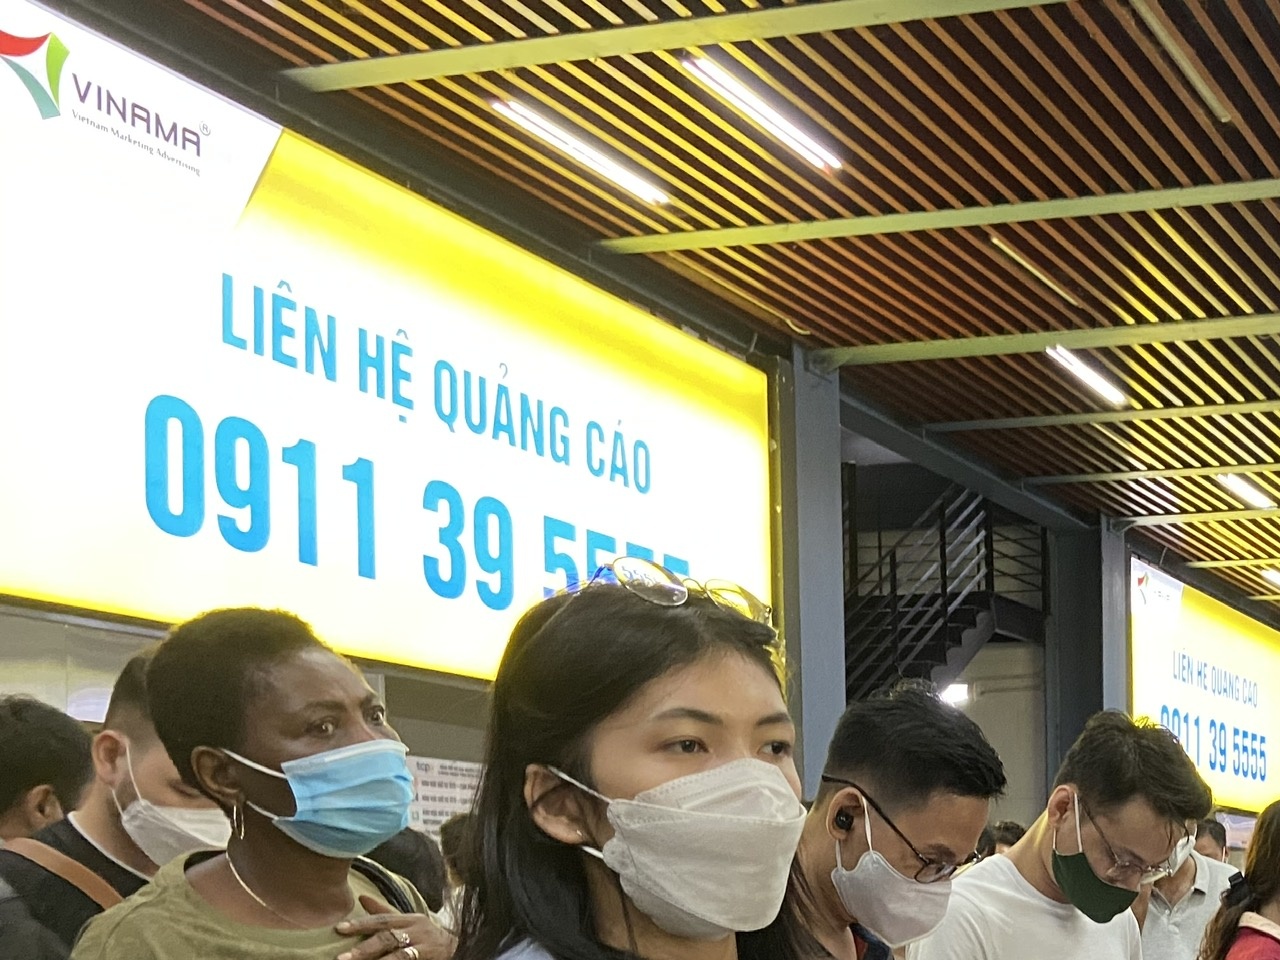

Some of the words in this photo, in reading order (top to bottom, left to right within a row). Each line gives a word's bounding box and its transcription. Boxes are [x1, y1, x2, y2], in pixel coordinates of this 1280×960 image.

[72, 109, 109, 133] Vietnam
[111, 127, 154, 155] Marketing
[156, 147, 201, 177] Advertising
[221, 273, 337, 383] LIÊN
[358, 328, 415, 423] HỆ
[434, 359, 571, 465] QUẢNG
[585, 420, 652, 495] CÁO
[144, 394, 377, 581] 0911
[422, 480, 515, 612] 39
[543, 514, 690, 599] 55
[1209, 718, 1227, 773] 39
[1232, 726, 1267, 782] 5555
